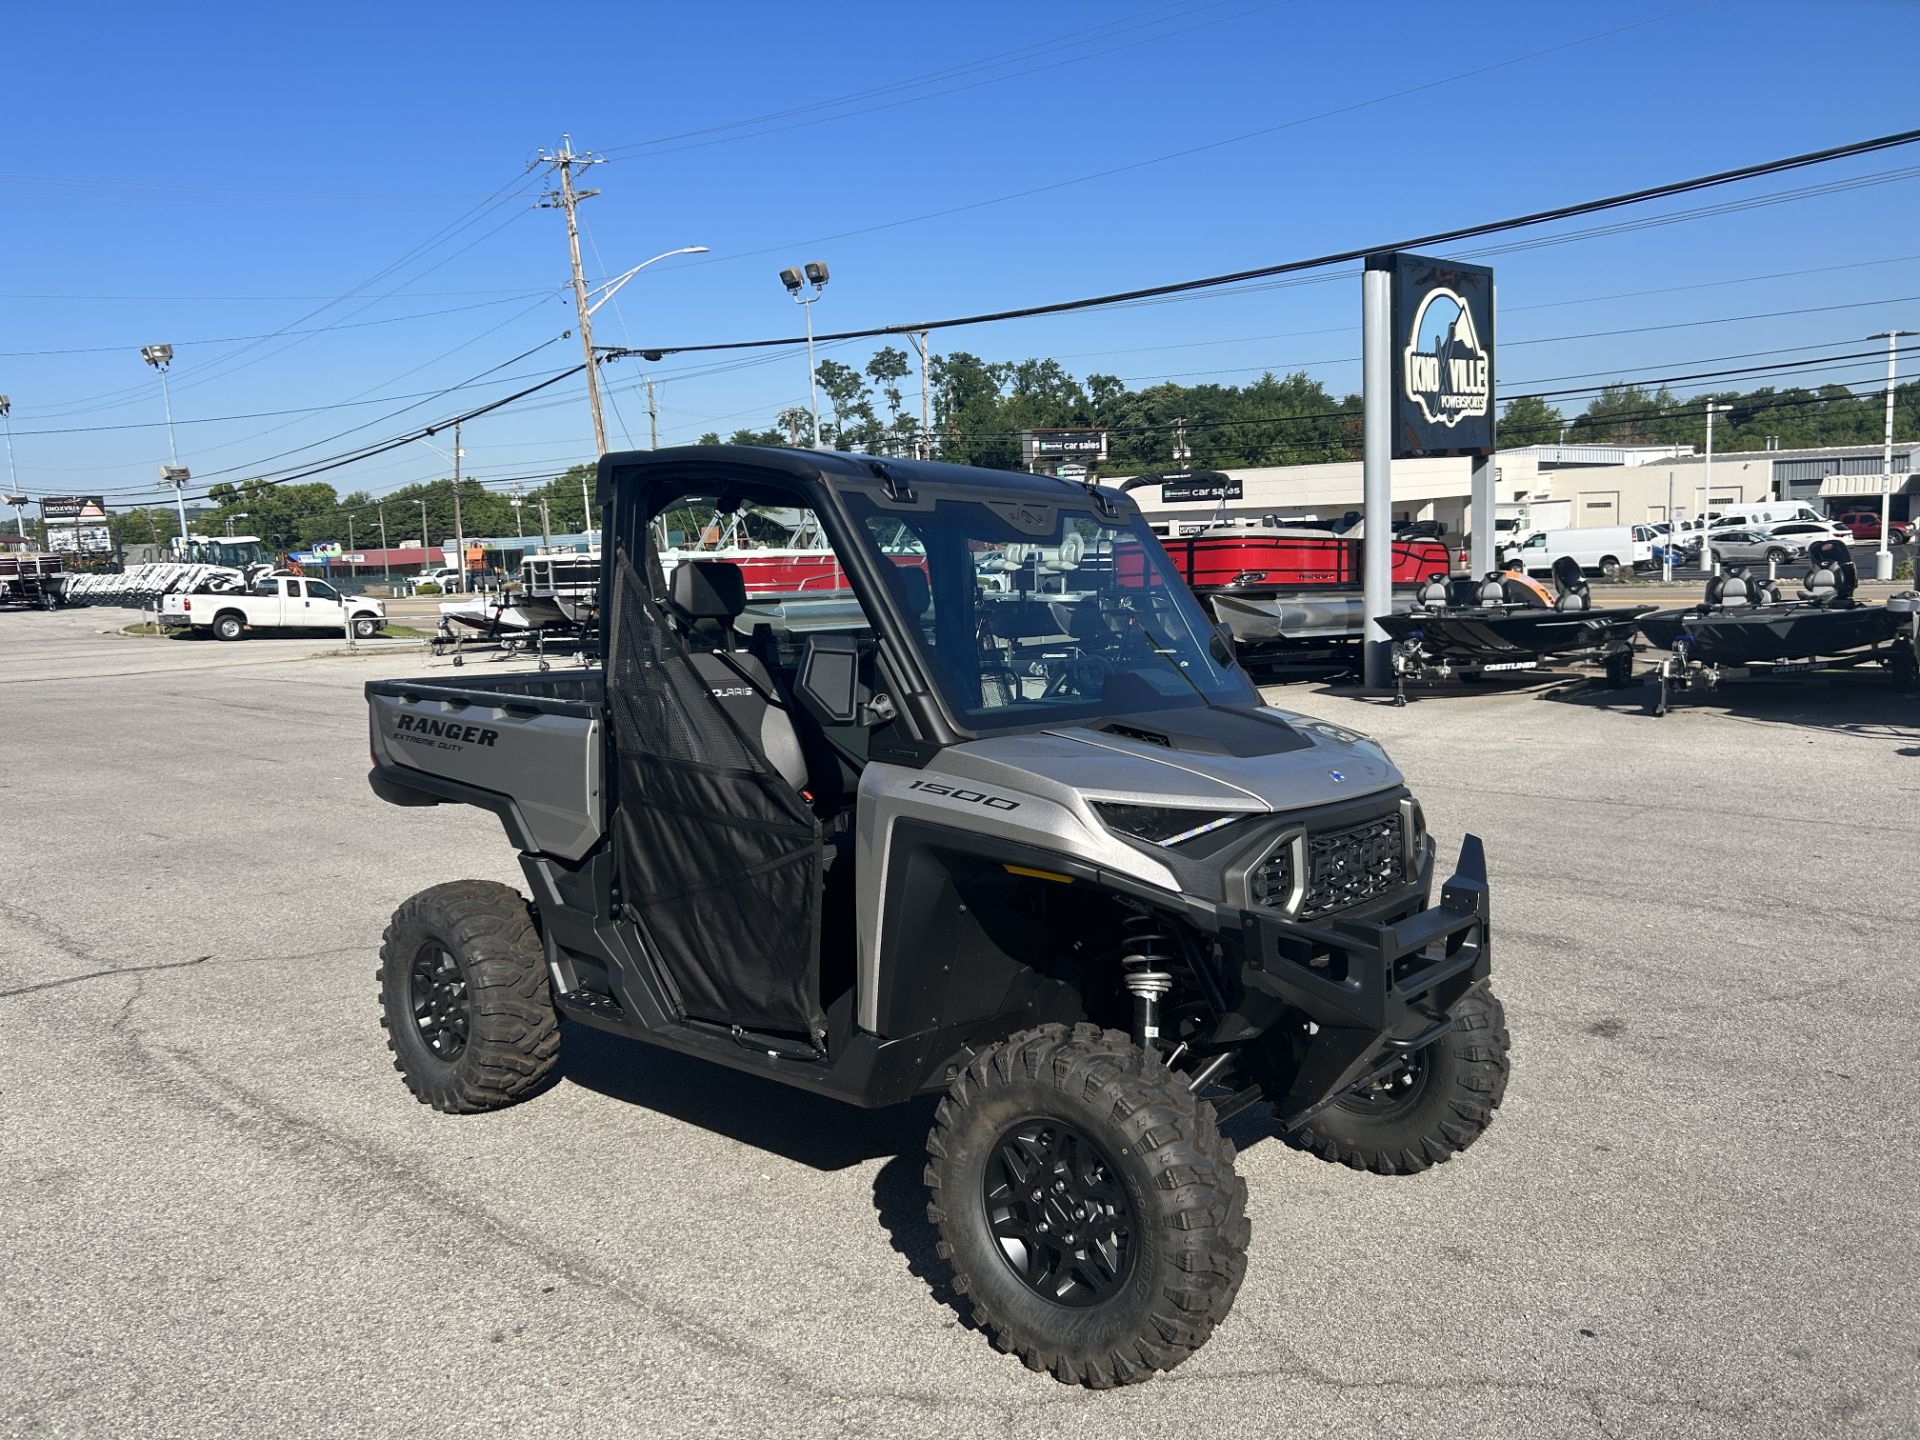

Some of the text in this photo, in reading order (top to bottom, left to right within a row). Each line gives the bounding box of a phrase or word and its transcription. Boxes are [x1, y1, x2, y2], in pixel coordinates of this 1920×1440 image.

[1411, 355, 1486, 394] KNOXVILLE
[1441, 395, 1485, 409] POWERSPORTS
[1078, 440, 1100, 450] sales
[1192, 488, 1210, 496] car
[1212, 486, 1240, 496] saes
[1484, 661, 1537, 672] CRESTLINER
[1772, 662, 1828, 674] CRESTLINER
[397, 713, 499, 747] RANGER
[392, 732, 464, 752] EXTREME DUTY
[909, 780, 1020, 811] 1500
[1313, 834, 1400, 884] POLARIS
